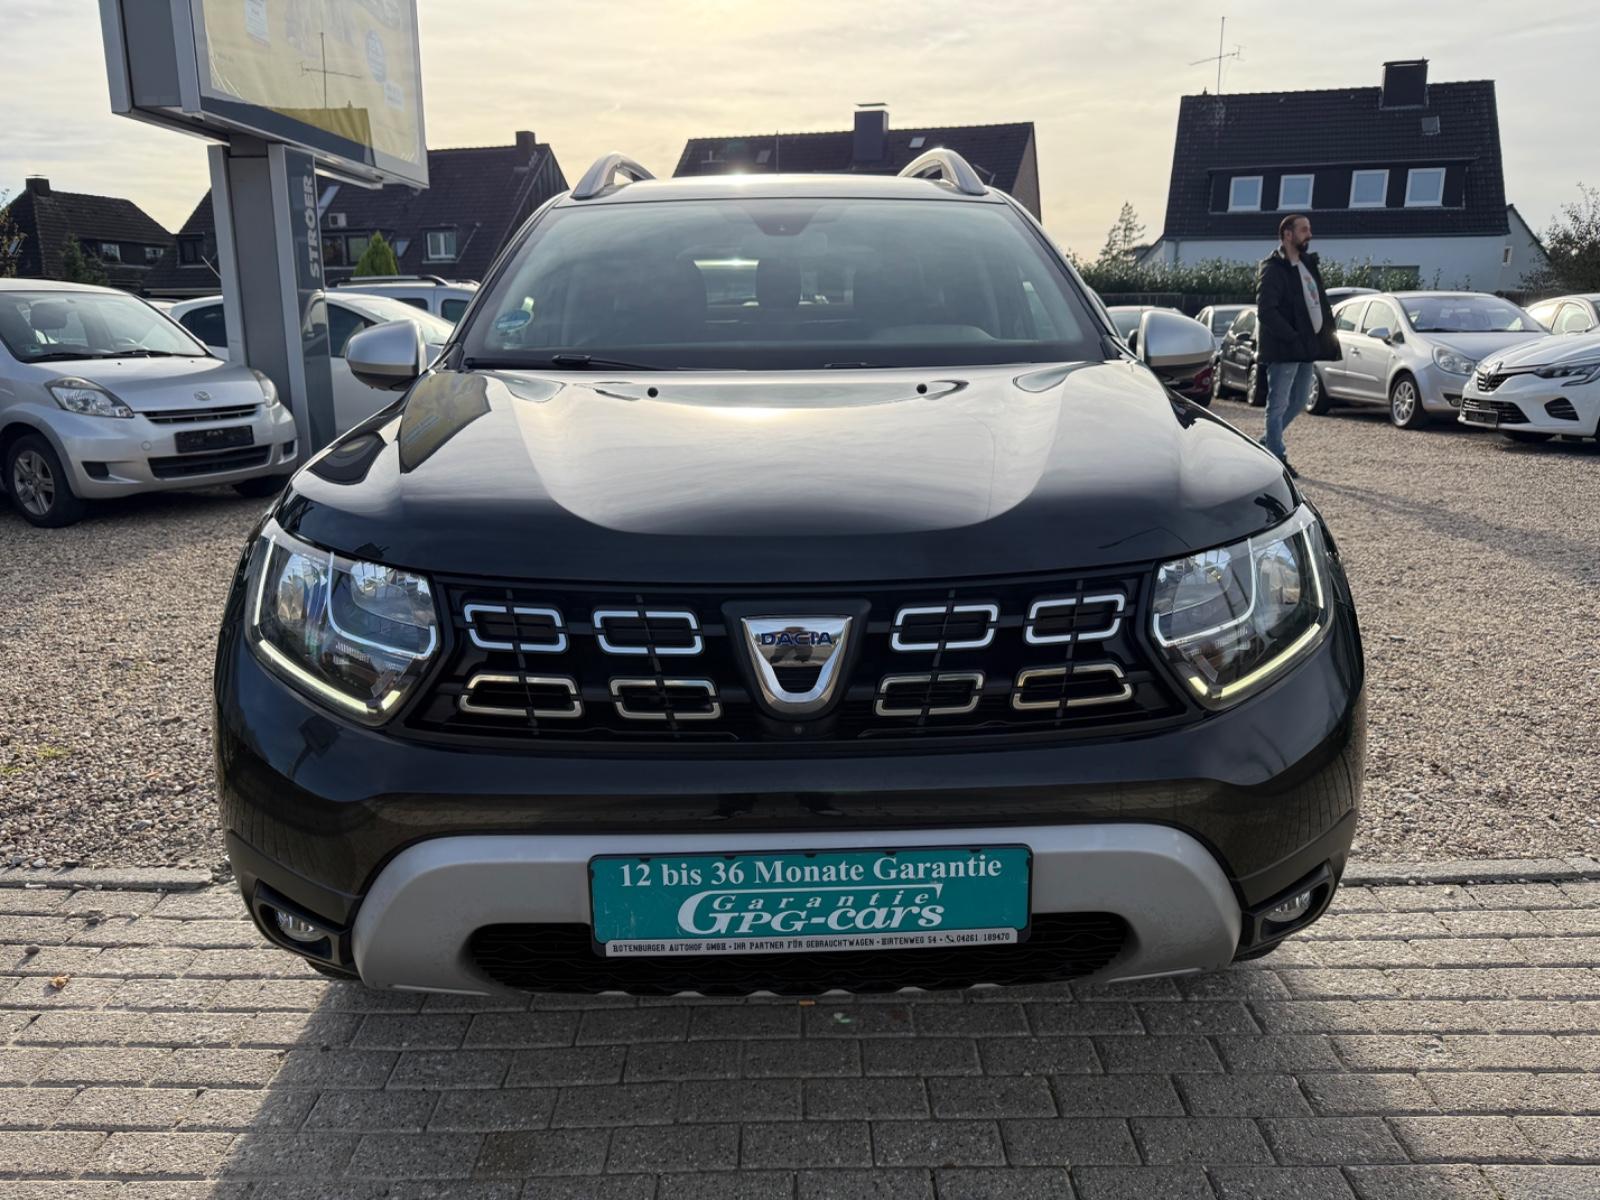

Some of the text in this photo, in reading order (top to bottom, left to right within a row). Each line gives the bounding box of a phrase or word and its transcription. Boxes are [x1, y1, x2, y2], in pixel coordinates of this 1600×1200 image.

[761, 632, 832, 645] DACIA
[620, 854, 1002, 887] 12 bis 36 Monate Garantie
[713, 890, 929, 911] Garantie
[677, 888, 945, 935] GPG-cars
[669, 942, 703, 952] AUTOHOF
[734, 940, 746, 950] IHR
[750, 939, 784, 950] PARTNER
[787, 937, 803, 949] FÜR
[806, 937, 874, 948] GEBRAUCHTWAGEN
[983, 932, 1010, 942] 189470
